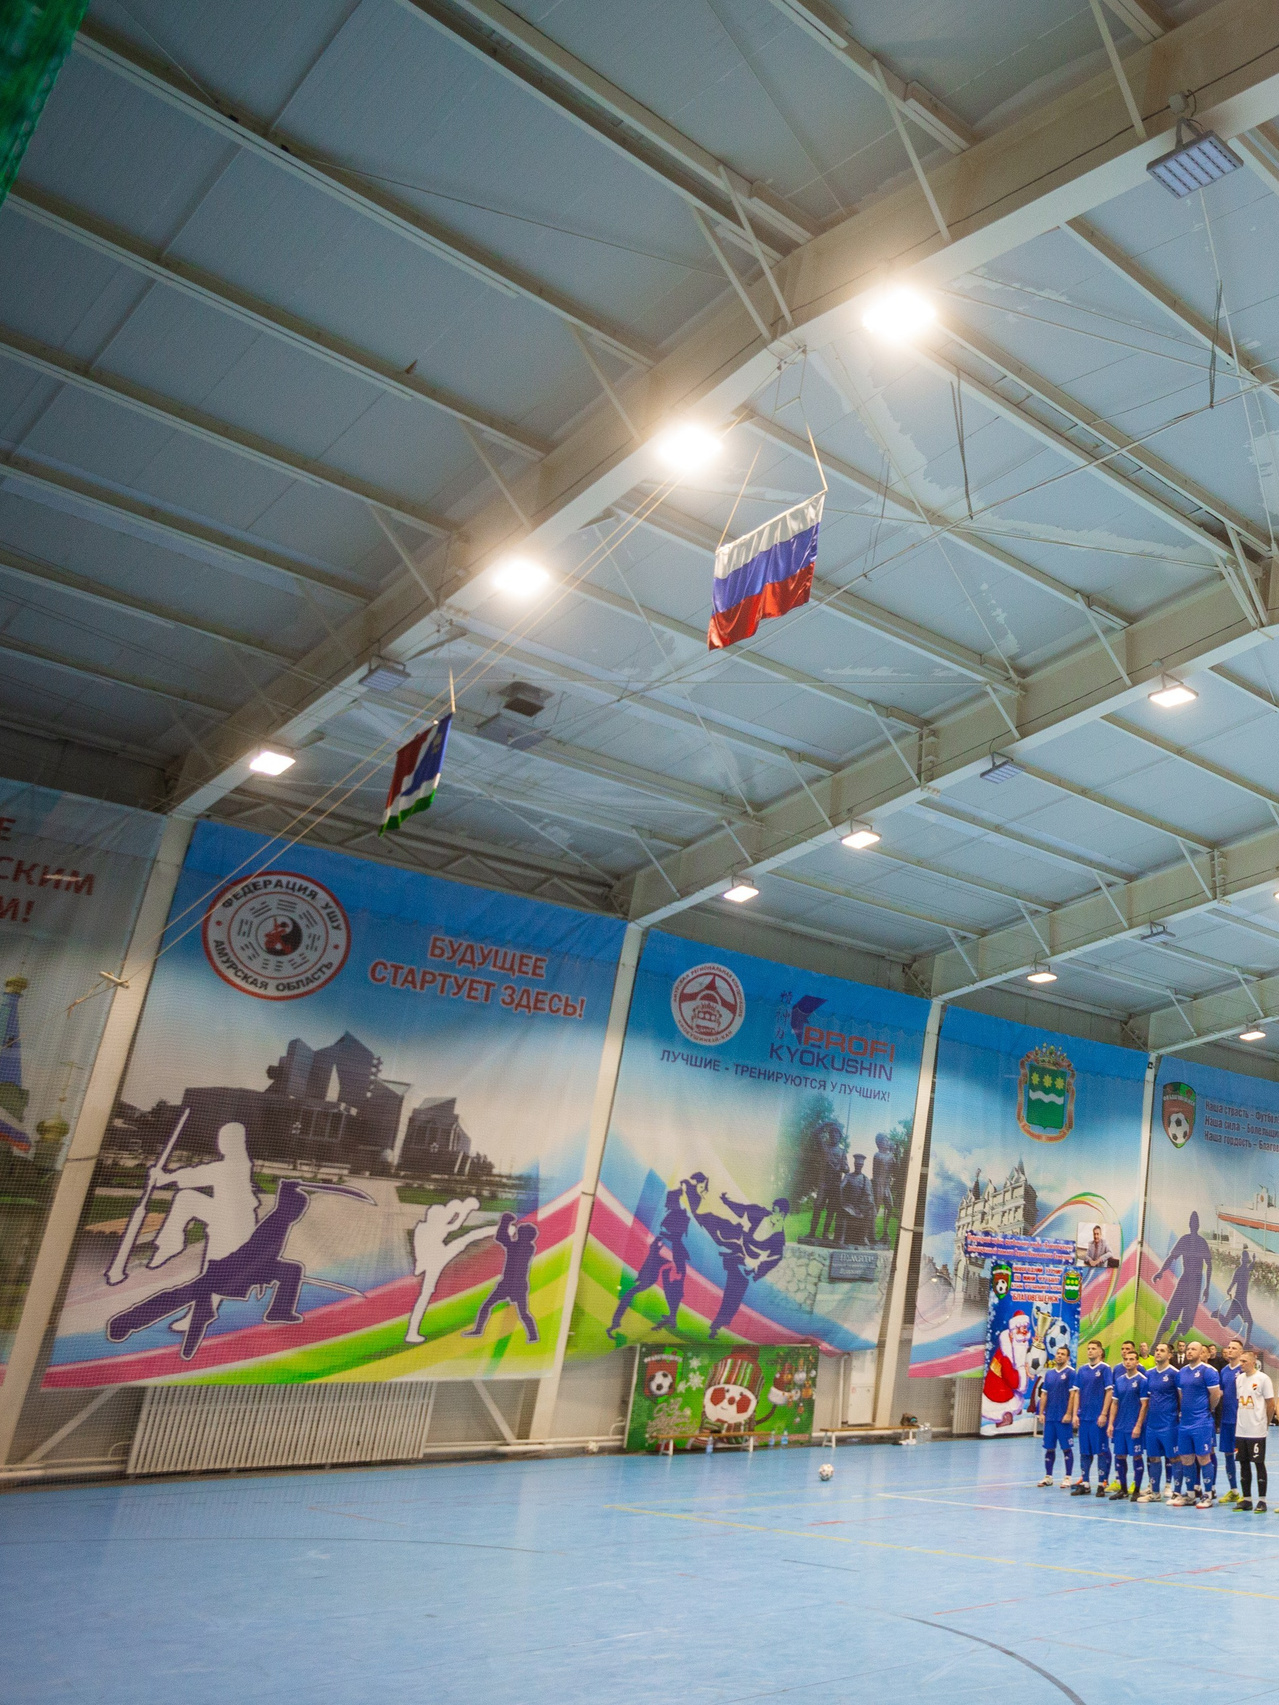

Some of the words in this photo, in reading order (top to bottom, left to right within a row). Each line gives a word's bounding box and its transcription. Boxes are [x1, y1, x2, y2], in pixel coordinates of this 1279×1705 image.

[222, 879, 319, 908] ФЕДЕРАЦИЯ
[321, 902, 342, 931] УШУ
[213, 939, 269, 991] АМУРСКАЯ
[275, 961, 334, 992] ОБЛАСТЬ
[428, 935, 547, 979] БУДУЩЕЕ
[368, 959, 497, 1004] СТАРТУЕТ
[500, 984, 587, 1019] ЗДЕСЬ!
[803, 1025, 895, 1063] PROFI
[661, 1050, 721, 1072] ЛУЧШИЕ
[734, 1063, 827, 1091] ТРЕНИРУЮТСЯ
[830, 1081, 838, 1093] У
[839, 1083, 890, 1102] ЛУЧШИХ!
[1204, 1130, 1222, 1143] Наша
[1205, 1115, 1223, 1129] Наша
[1253, 1443, 1259, 1454] 6
